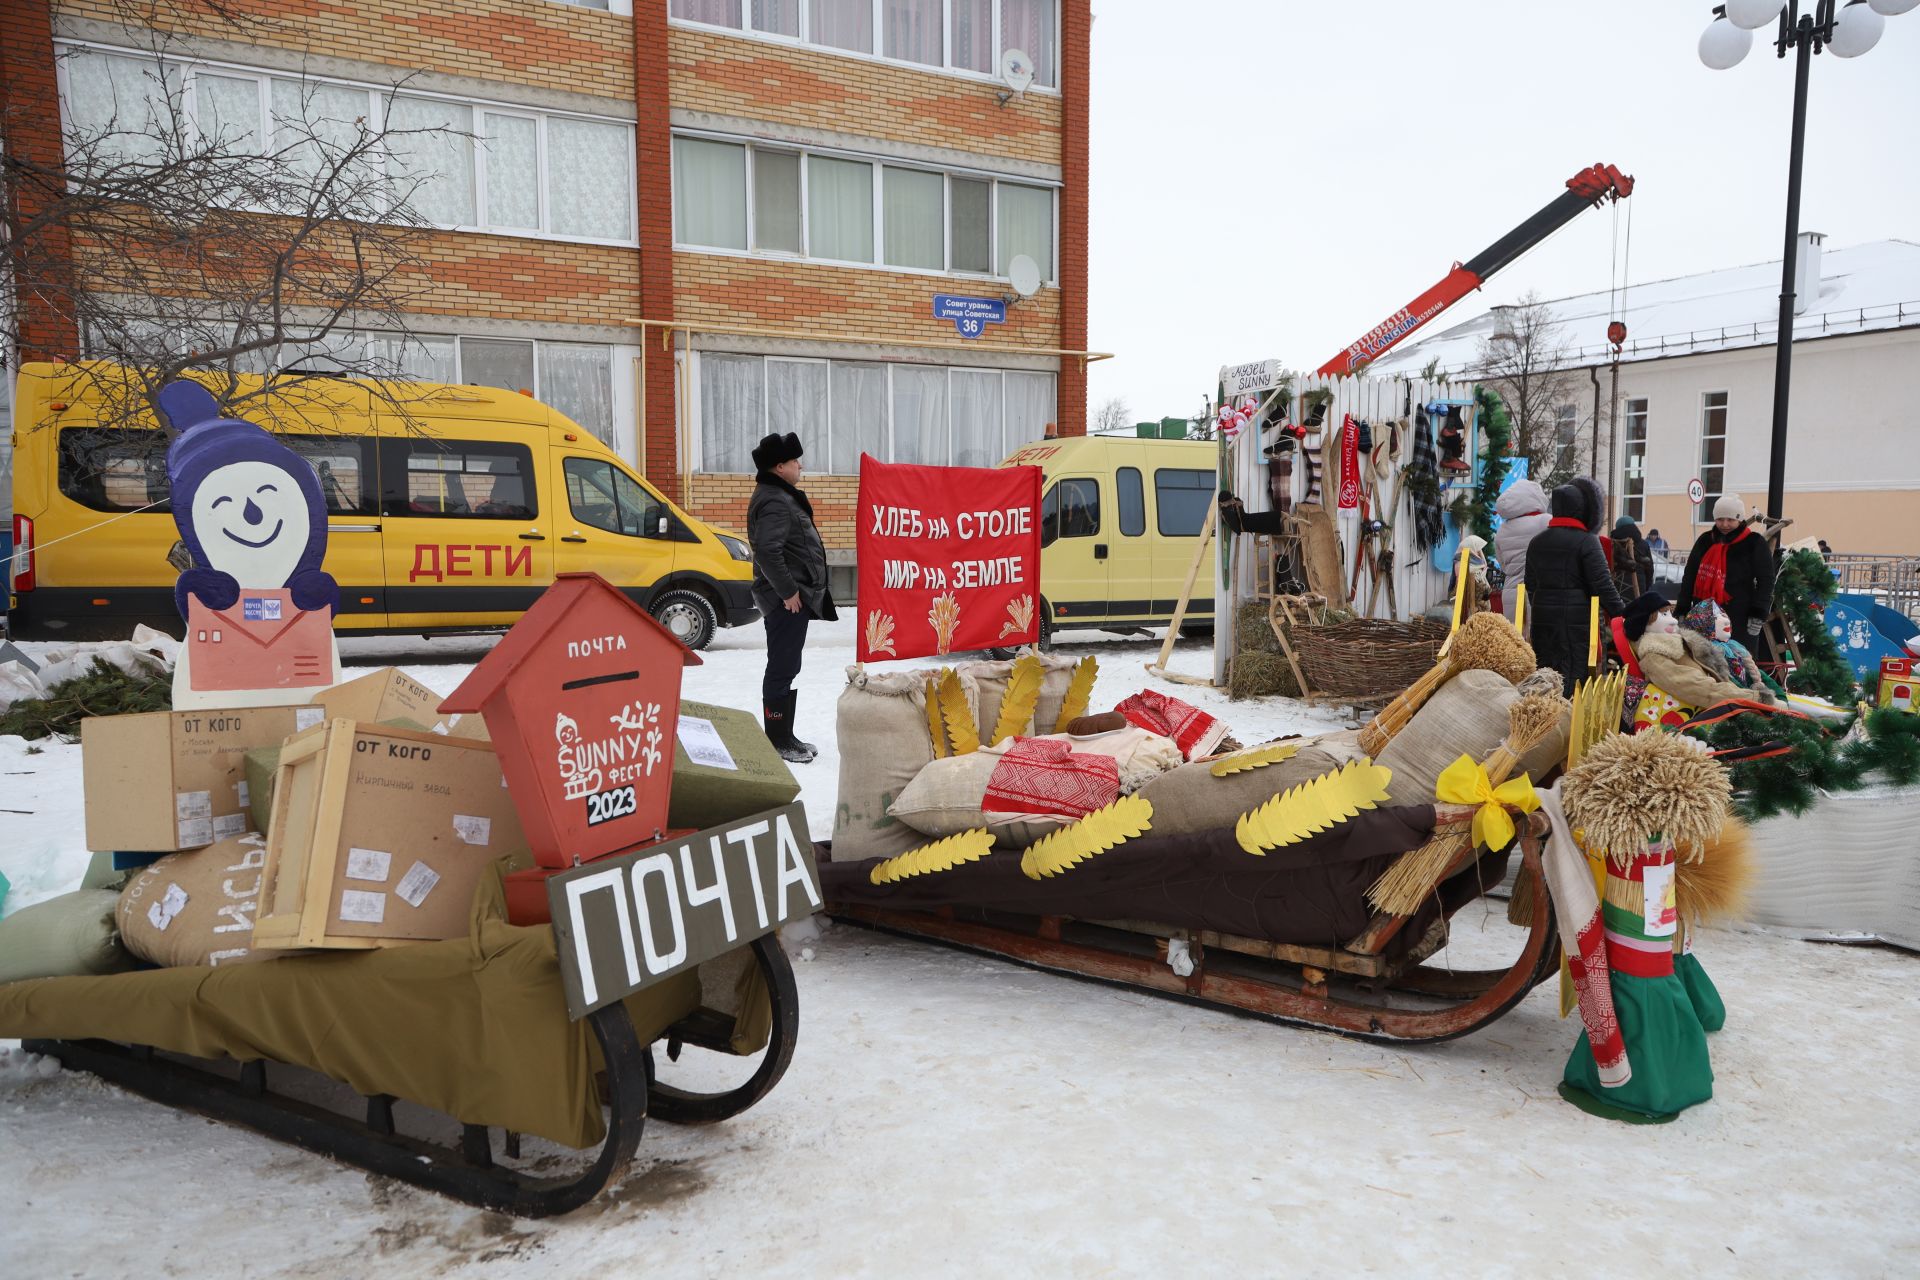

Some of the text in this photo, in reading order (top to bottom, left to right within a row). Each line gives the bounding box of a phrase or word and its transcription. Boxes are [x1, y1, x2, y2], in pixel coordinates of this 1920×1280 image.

[942, 308, 1000, 319] улица Советская
[946, 299, 992, 310] Совет урамы
[962, 319, 978, 333] 36
[1367, 315, 1418, 353] KANGLIM
[1239, 374, 1271, 390] SUNNY
[1691, 486, 1701, 497] 40
[871, 504, 924, 537] ХЛЕБ
[956, 506, 1032, 540] СТОЛЕ
[409, 543, 532, 583] ДЕТИ
[883, 559, 920, 589] МИР
[951, 556, 1024, 590] ЗЕМЛЕ
[567, 634, 627, 658] ПОЧТА
[184, 717, 241, 733] ОТ КОГО
[356, 739, 432, 762] ОТ КОГО
[557, 732, 641, 779] SUNNY
[608, 762, 643, 785] ФЕСТ
[588, 786, 637, 824] 2023
[565, 813, 821, 1006] ПОЧТА
